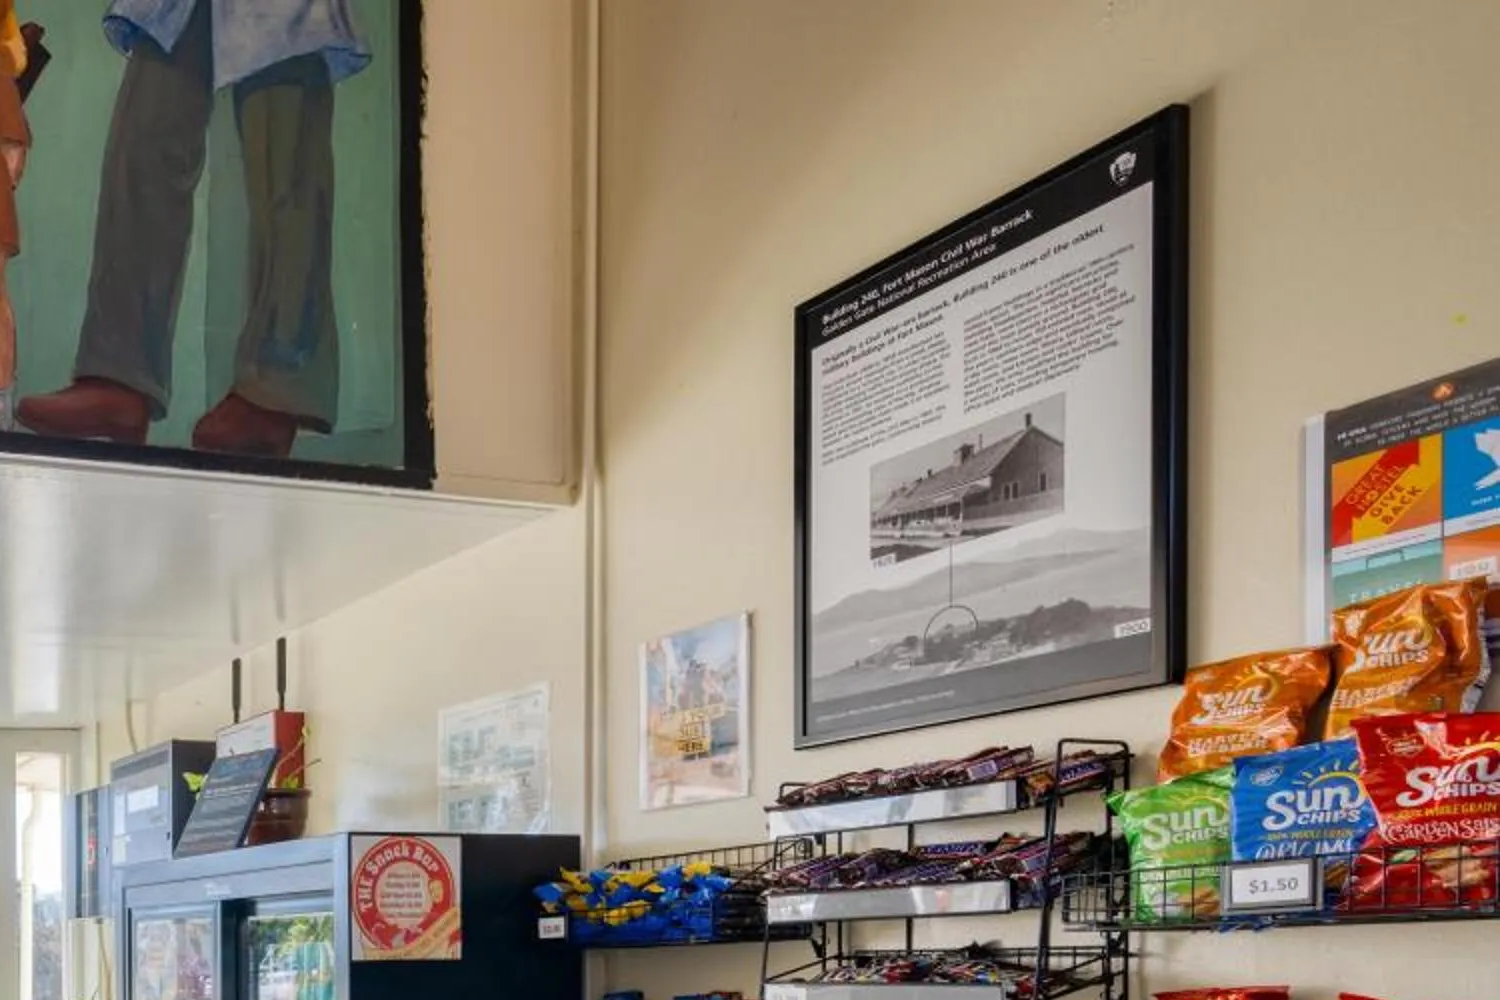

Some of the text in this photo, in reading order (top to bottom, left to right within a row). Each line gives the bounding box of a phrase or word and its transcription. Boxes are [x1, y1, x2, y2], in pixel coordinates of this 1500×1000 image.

[883, 277, 902, 294] Fort
[905, 259, 938, 284] Mason
[941, 244, 963, 263] Civil
[965, 232, 987, 250] War
[991, 209, 1033, 237] Barrack
[877, 284, 914, 308] National
[917, 257, 969, 289] Recreation
[971, 242, 997, 261] Area
[1369, 482, 1406, 518] GIVE
[1381, 484, 1424, 525] BACK
[1262, 785, 1368, 831] Sun
[1297, 808, 1362, 826] CHIPS
[1461, 801, 1498, 814] GRAIN
[1143, 805, 1229, 851] Sun
[1171, 826, 1229, 844] CHIPS
[1248, 876, 1300, 895] $1.50
